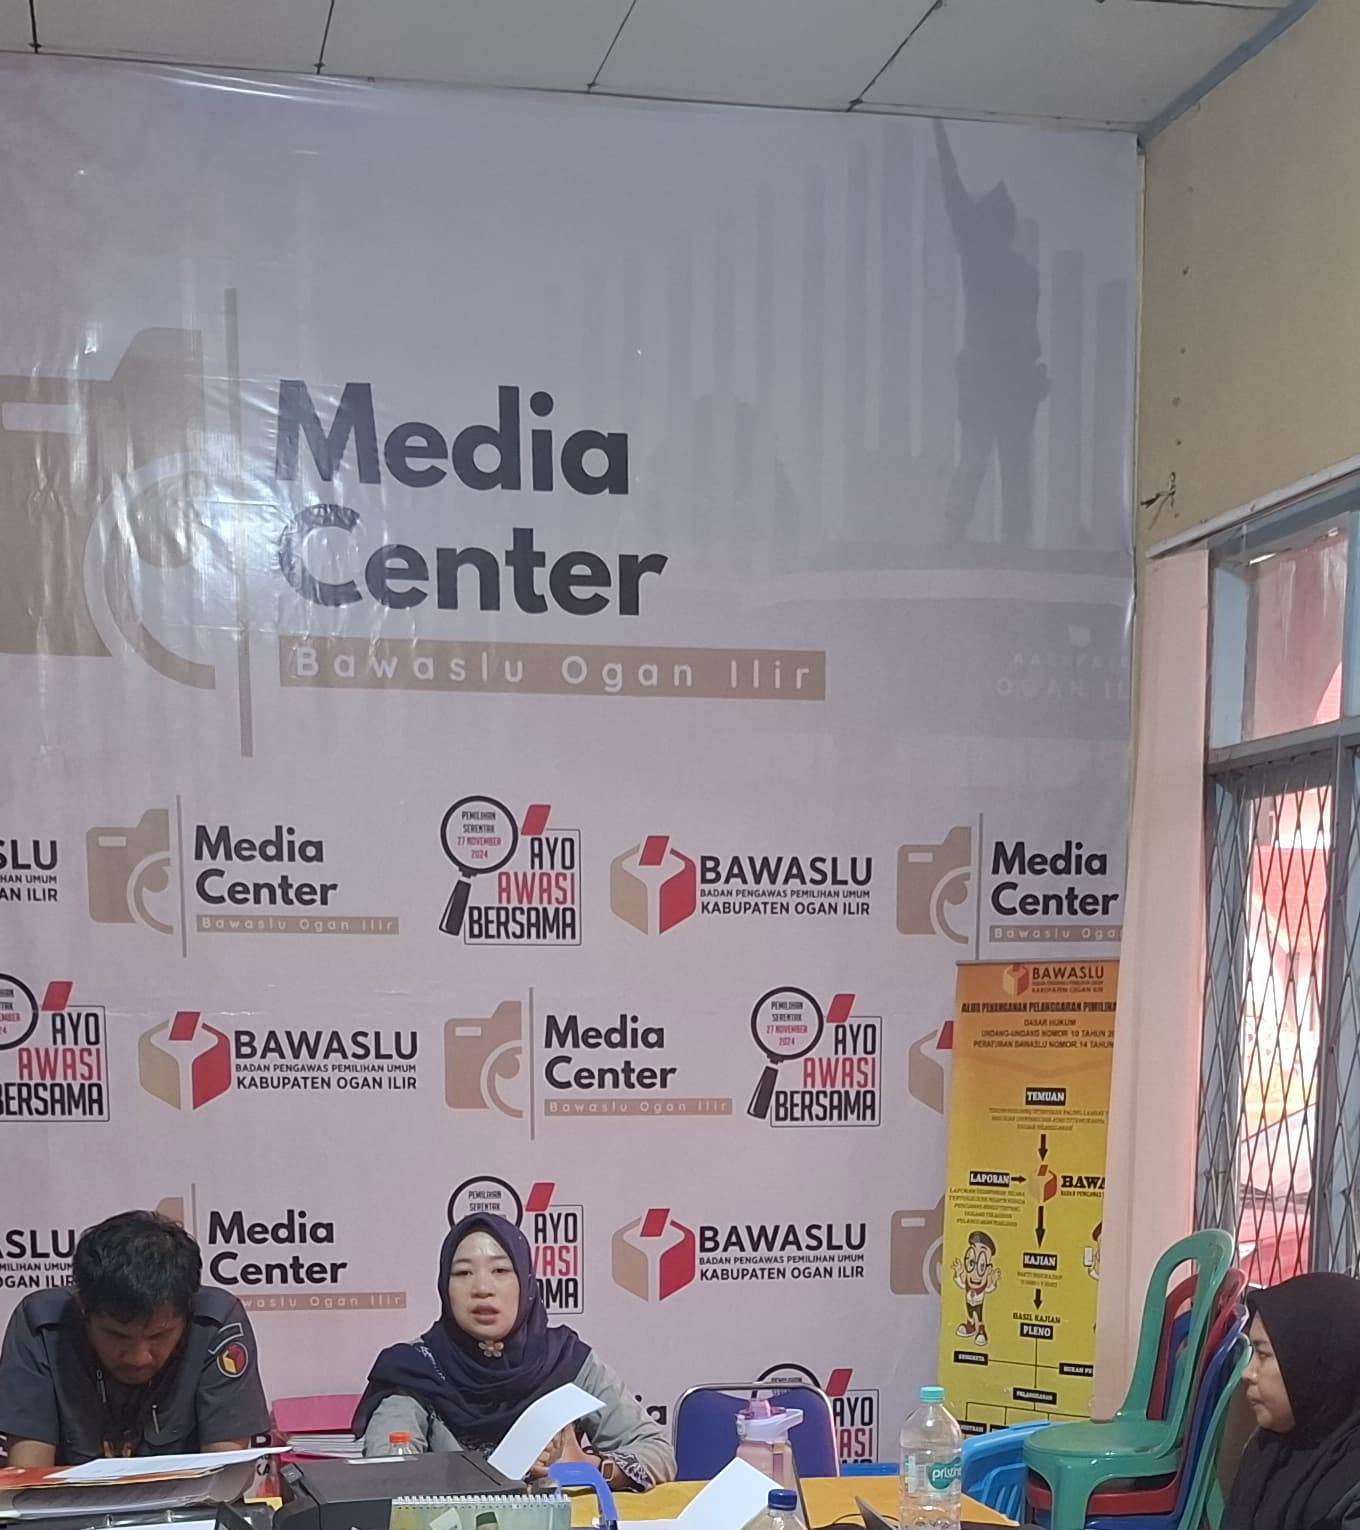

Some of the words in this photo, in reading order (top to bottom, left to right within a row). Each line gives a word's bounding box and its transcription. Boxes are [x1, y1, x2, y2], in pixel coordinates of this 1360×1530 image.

[275, 379, 629, 496] Media
[279, 503, 669, 616] Center
[297, 646, 525, 685] Bawaslu
[562, 654, 693, 692] Ogan
[730, 659, 809, 690] Ilir
[194, 825, 325, 864] Media
[530, 837, 575, 870] AYO
[992, 840, 1107, 876] Media
[25, 875, 57, 884] UMUM
[700, 856, 872, 886] BAWASLU
[27, 888, 58, 902] ILIR
[195, 869, 339, 906] Center
[497, 872, 575, 905] AWASI
[700, 888, 732, 897] BADAN
[735, 888, 788, 898] PENGAWAS
[790, 889, 839, 898] PEMILIHAN
[842, 889, 871, 898] UMUM
[991, 881, 1120, 916] Center
[468, 906, 576, 940] BERSAMA
[701, 901, 791, 915] KABUPATEN
[794, 902, 839, 916] OGAN
[843, 902, 871, 916] ILIR
[202, 918, 289, 931] Bawaslu
[299, 919, 351, 934] Ogan
[362, 919, 394, 932] Ilir
[994, 928, 1070, 938] Bawaslu
[1032, 966, 1104, 980] BAWASLU
[51, 1012, 100, 1046] AYO
[545, 1015, 665, 1050] Media
[834, 1024, 877, 1055] AYO
[234, 1030, 418, 1060] BAWASLU
[18, 1047, 102, 1081] AWASI
[235, 1063, 270, 1072] BADAN
[273, 1063, 329, 1073] PENGAWAS
[331, 1064, 385, 1074] PEMILIHAN
[386, 1064, 417, 1073] UMUM
[545, 1055, 677, 1090] Center
[803, 1057, 876, 1088] AWASI
[236, 1076, 332, 1090] KABUPATEN
[336, 1076, 384, 1090] OGAN
[388, 1076, 417, 1090] ILIR
[1027, 1091, 1065, 1102] TEMUAN
[549, 1101, 629, 1113] Bawaslu
[640, 1101, 687, 1115] Ogan
[775, 1090, 876, 1121] BERSAMA
[970, 1173, 1010, 1185] LAPORAN
[209, 1210, 335, 1245] Media
[534, 1213, 578, 1244] AYO
[699, 1223, 867, 1252] BAWASLU
[210, 1251, 348, 1286] Center
[699, 1256, 731, 1265] BADAN
[733, 1256, 784, 1265] PENGAWAS
[786, 1255, 836, 1265] PEMILIHAN
[837, 1254, 865, 1263] UMUM
[700, 1268, 787, 1281] KABUPATEN
[790, 1267, 835, 1280] OGAN
[838, 1265, 865, 1279] ILIR
[1024, 1254, 1056, 1267] KAJIAN
[309, 1295, 359, 1310] Ogan
[370, 1295, 402, 1307] Ilir
[1023, 1324, 1051, 1337] PLENO
[835, 1397, 874, 1428] AYO
